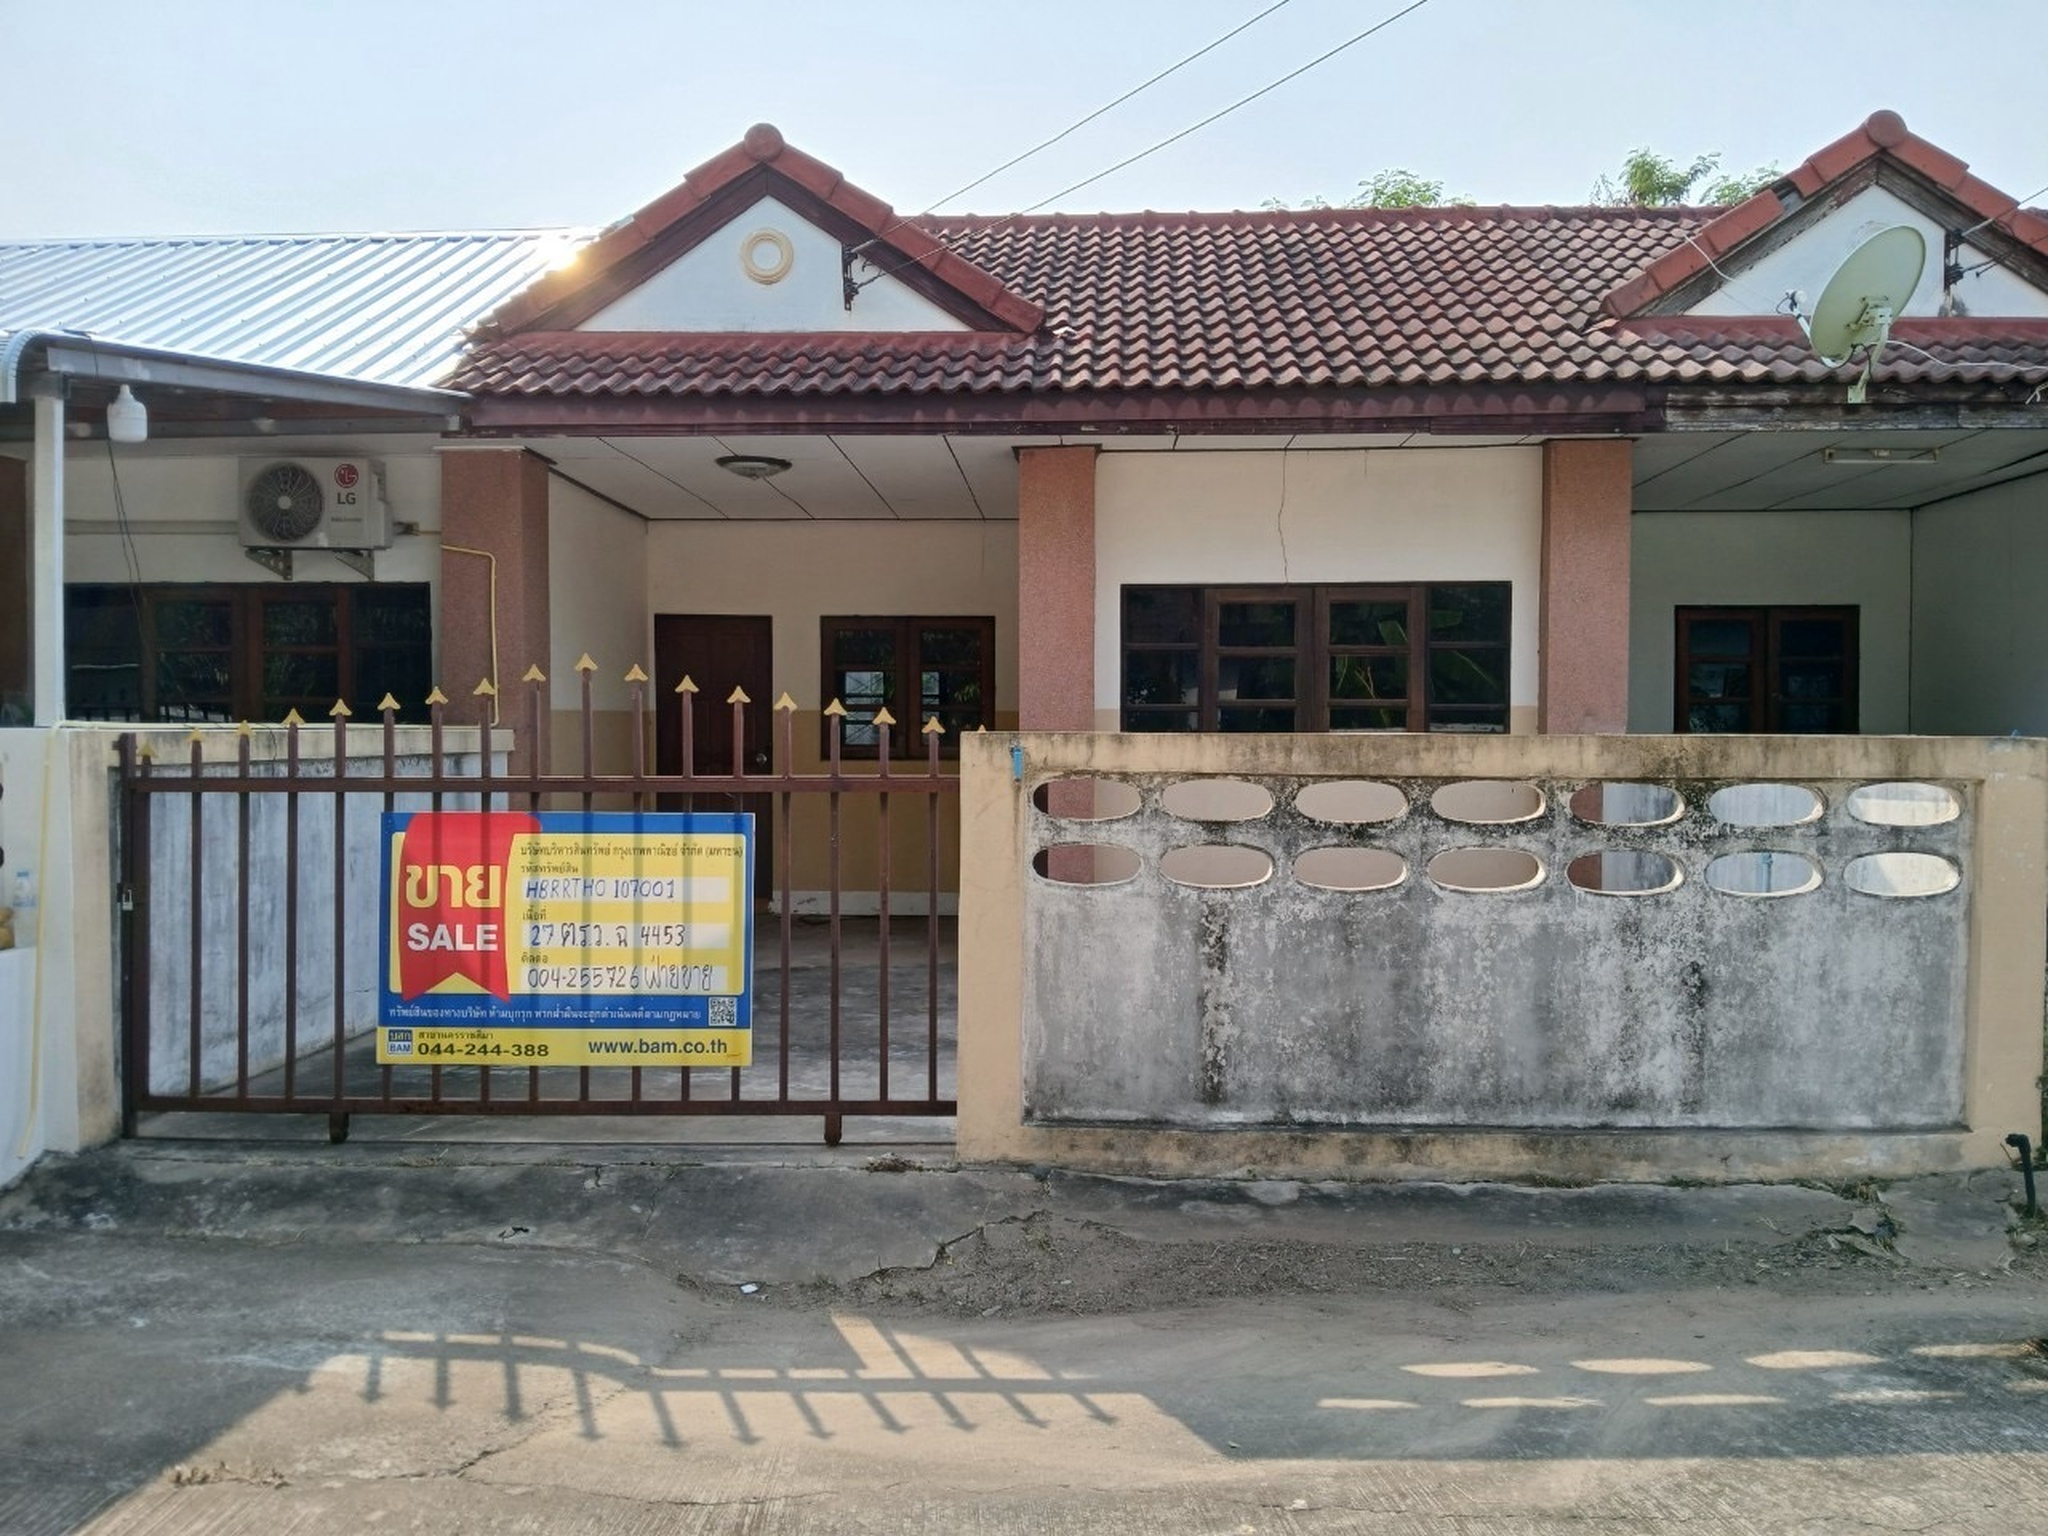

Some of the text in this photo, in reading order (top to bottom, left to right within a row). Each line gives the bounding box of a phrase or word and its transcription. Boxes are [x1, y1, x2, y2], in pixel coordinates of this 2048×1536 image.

[337, 492, 357, 505] LG
[405, 864, 501, 908] ขาย
[407, 922, 499, 952] SALE
[530, 924, 554, 947] 27
[640, 924, 687, 947] 4453
[389, 1043, 412, 1053] BAM
[417, 1042, 549, 1058] 044-244-388
[588, 1038, 728, 1055] www.bam.co.th
